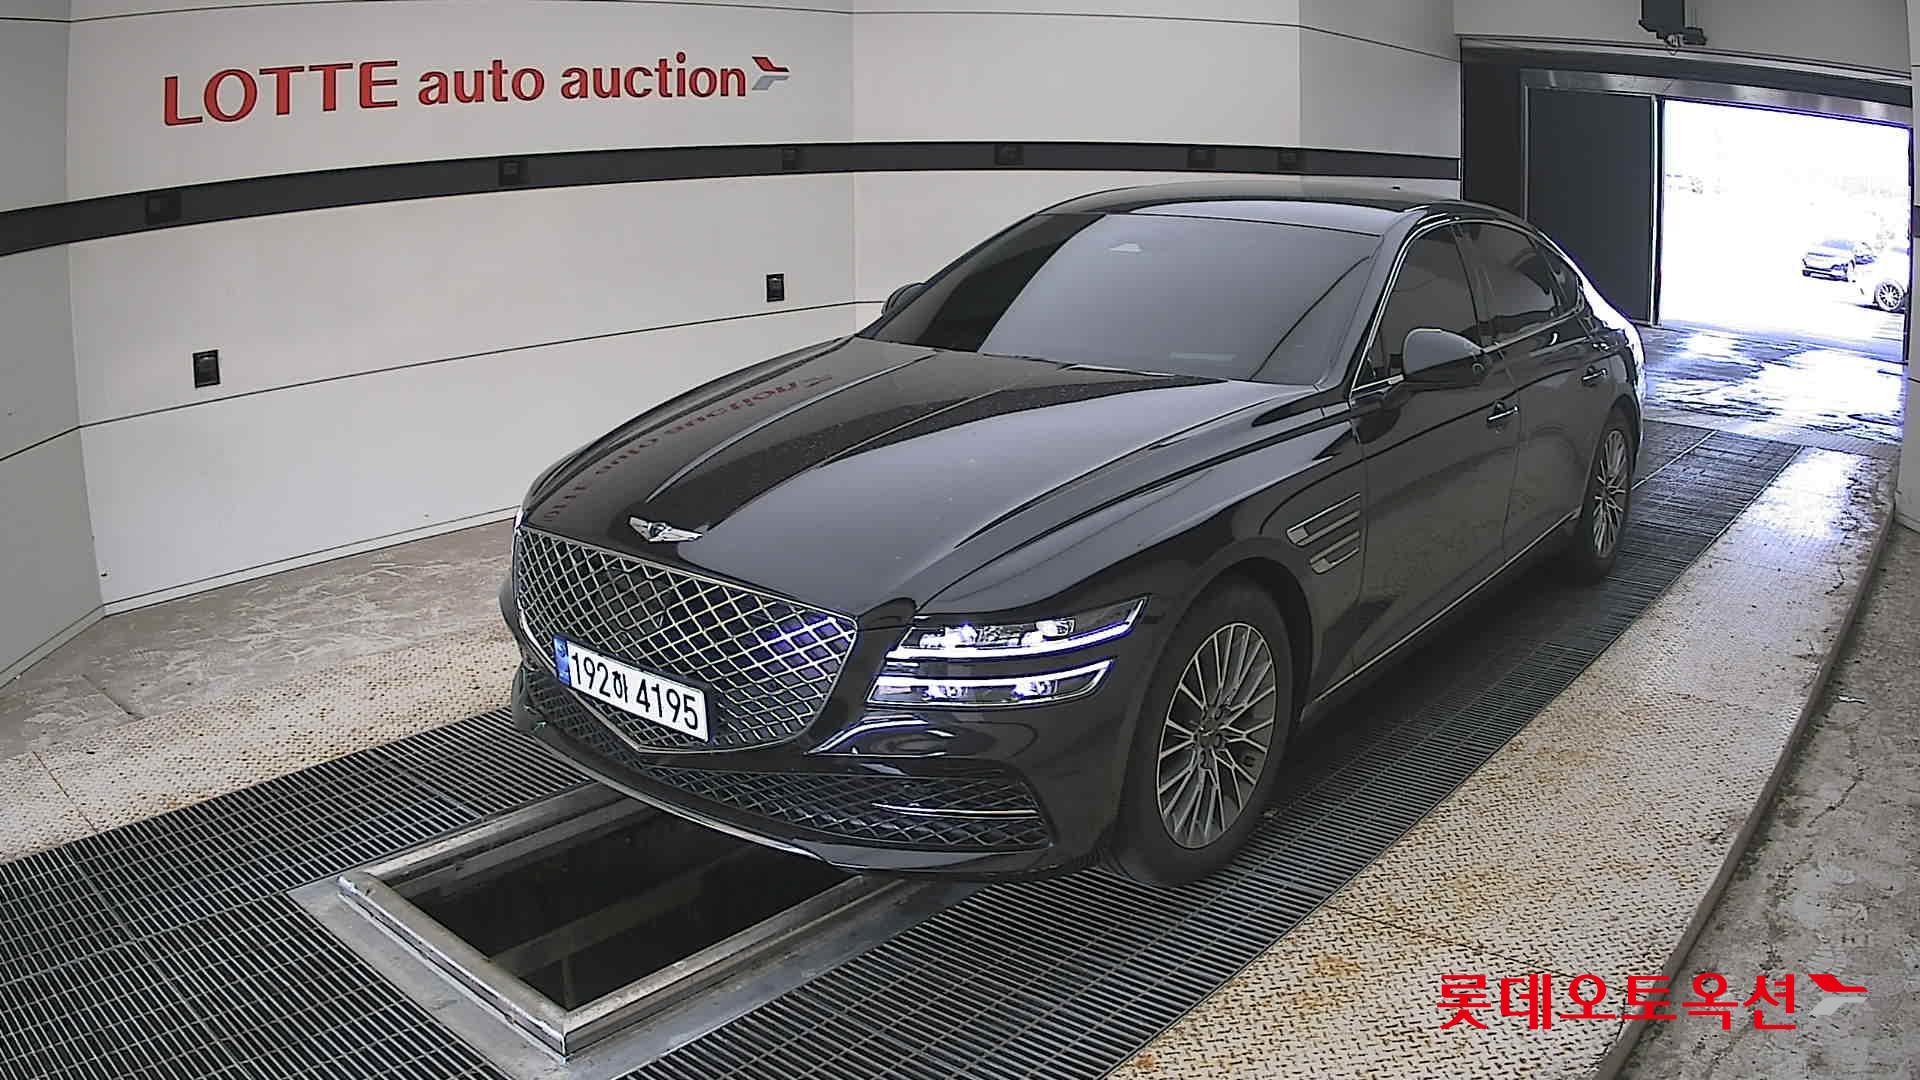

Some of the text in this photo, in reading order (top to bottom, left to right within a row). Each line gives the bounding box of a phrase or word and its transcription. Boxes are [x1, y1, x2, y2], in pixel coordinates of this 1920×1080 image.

[163, 52, 747, 127] LOTTE auto auction
[636, 679, 699, 731] 4195
